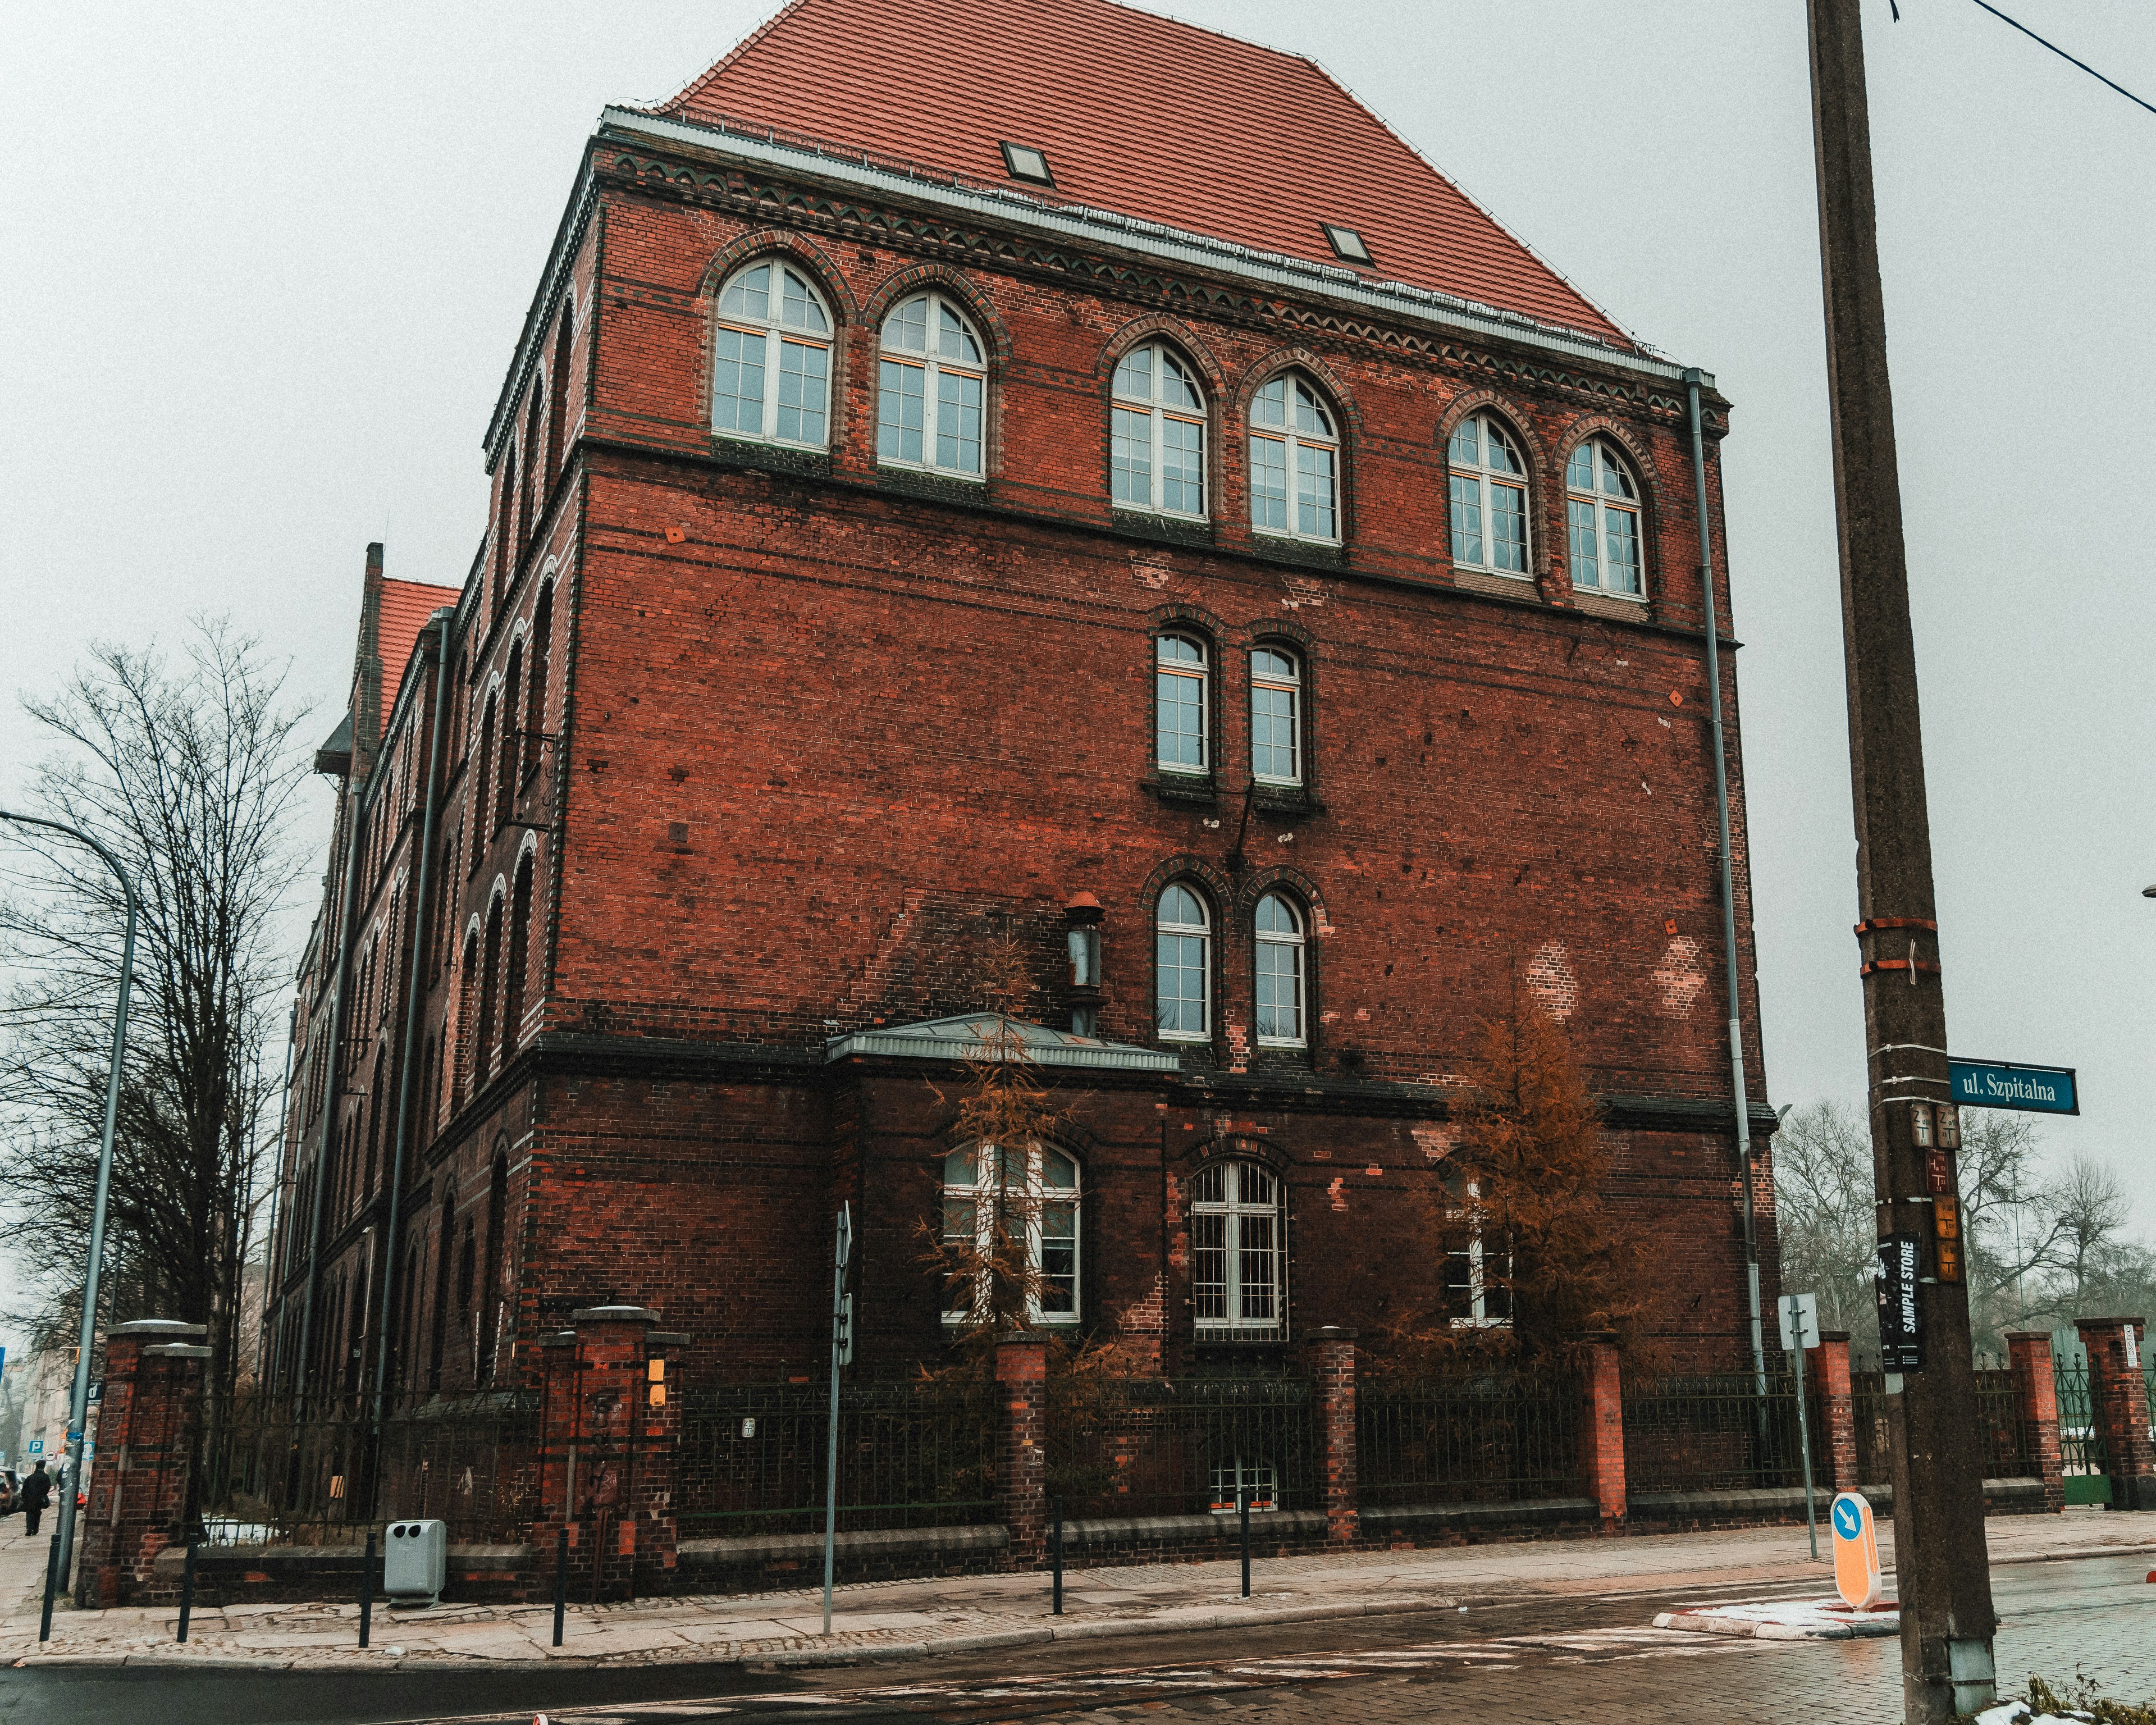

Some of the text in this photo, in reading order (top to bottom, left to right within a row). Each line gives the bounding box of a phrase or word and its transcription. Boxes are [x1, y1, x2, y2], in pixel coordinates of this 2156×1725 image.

[1963, 1073, 2056, 1102] ul. Szpitalna
[1901, 1241, 1913, 1280] STORE
[1902, 1283, 1916, 1334] SAMPLE
